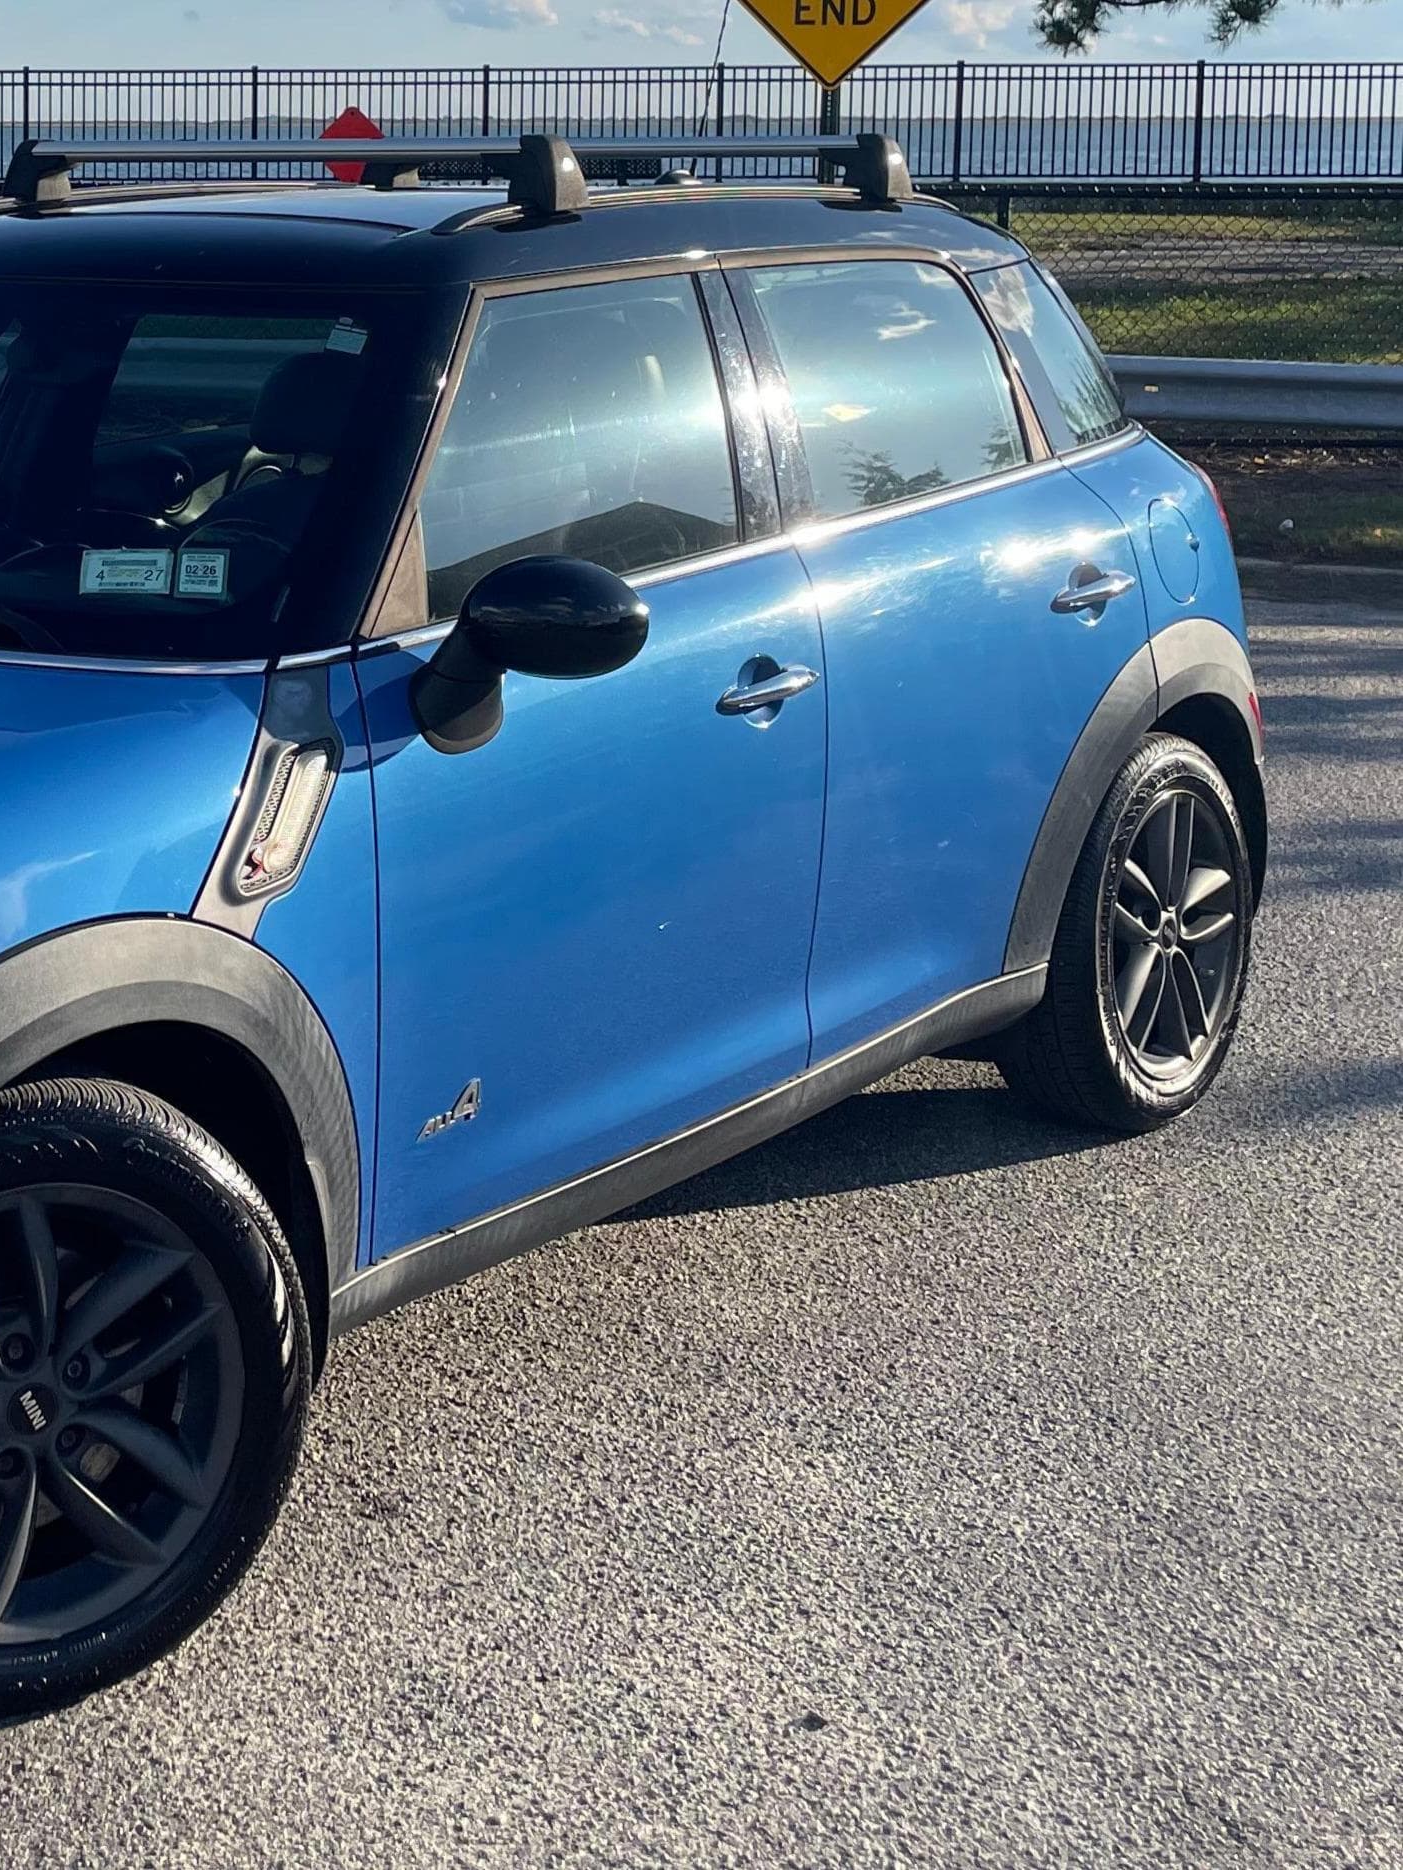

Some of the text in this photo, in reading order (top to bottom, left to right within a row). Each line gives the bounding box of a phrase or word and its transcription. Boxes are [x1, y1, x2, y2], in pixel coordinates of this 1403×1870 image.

[794, 0, 876, 26] END
[95, 569, 105, 581] 4
[144, 569, 164, 581] 27
[19, 1390, 47, 1431] MINI
